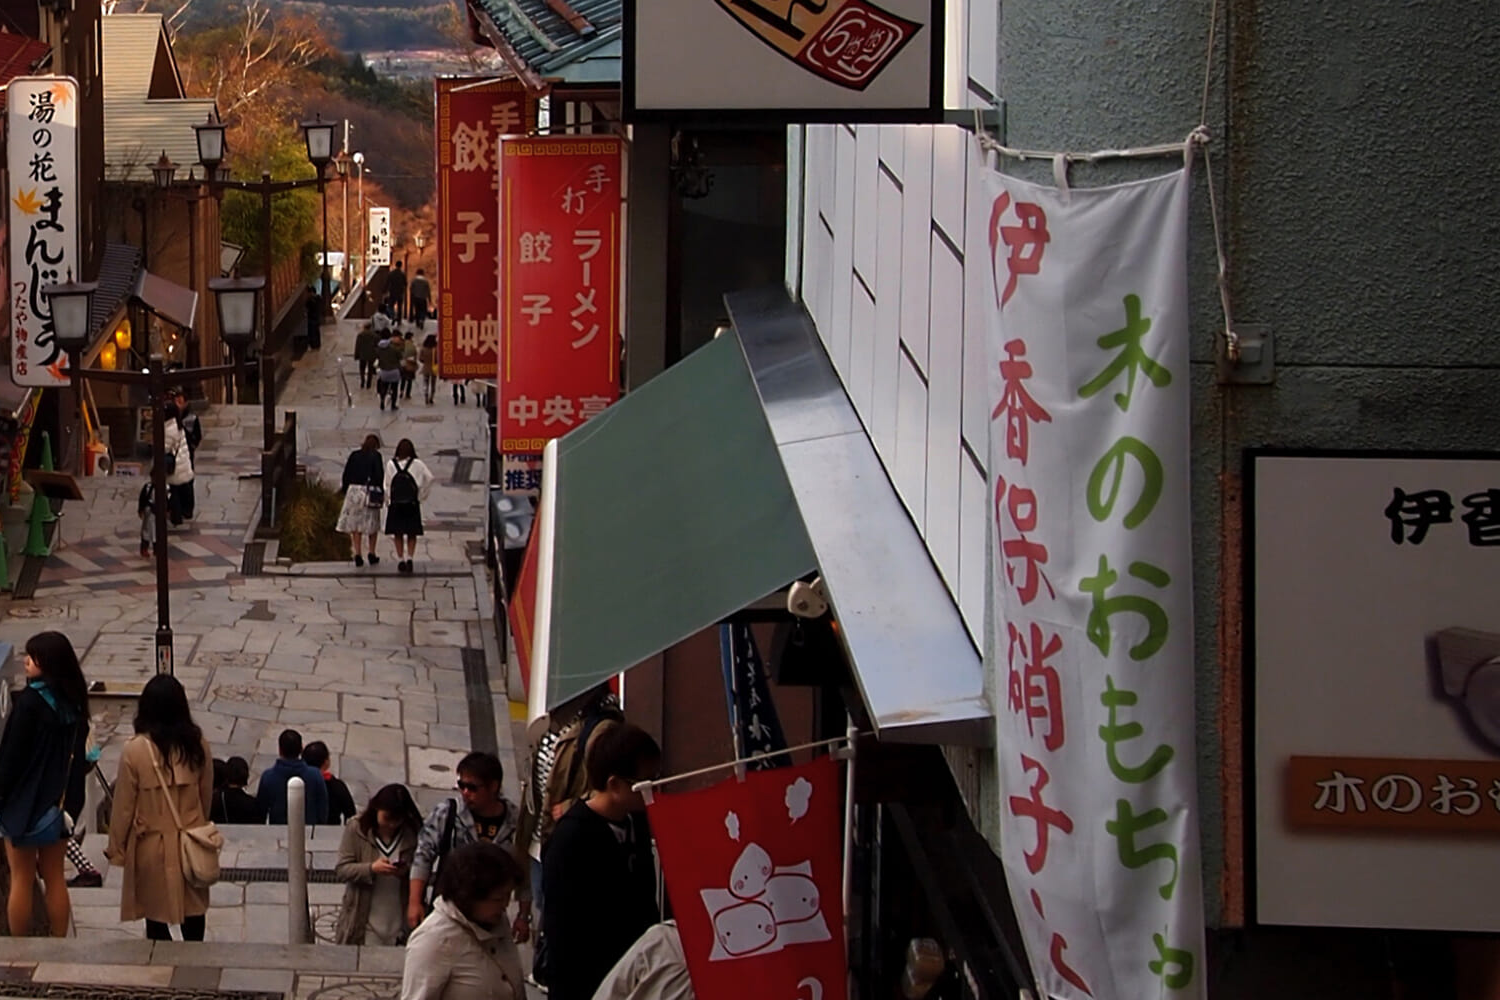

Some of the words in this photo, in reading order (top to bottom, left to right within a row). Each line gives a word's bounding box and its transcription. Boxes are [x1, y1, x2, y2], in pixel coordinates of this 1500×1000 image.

[451, 121, 490, 264] 餃子
[561, 164, 611, 215] 手打
[518, 230, 554, 327] 餃子
[569, 229, 602, 350] ラーメン
[14, 280, 29, 376] つたや物産店
[1077, 294, 1194, 990] 木のおもちゃ
[1313, 771, 1500, 817] 木のお
